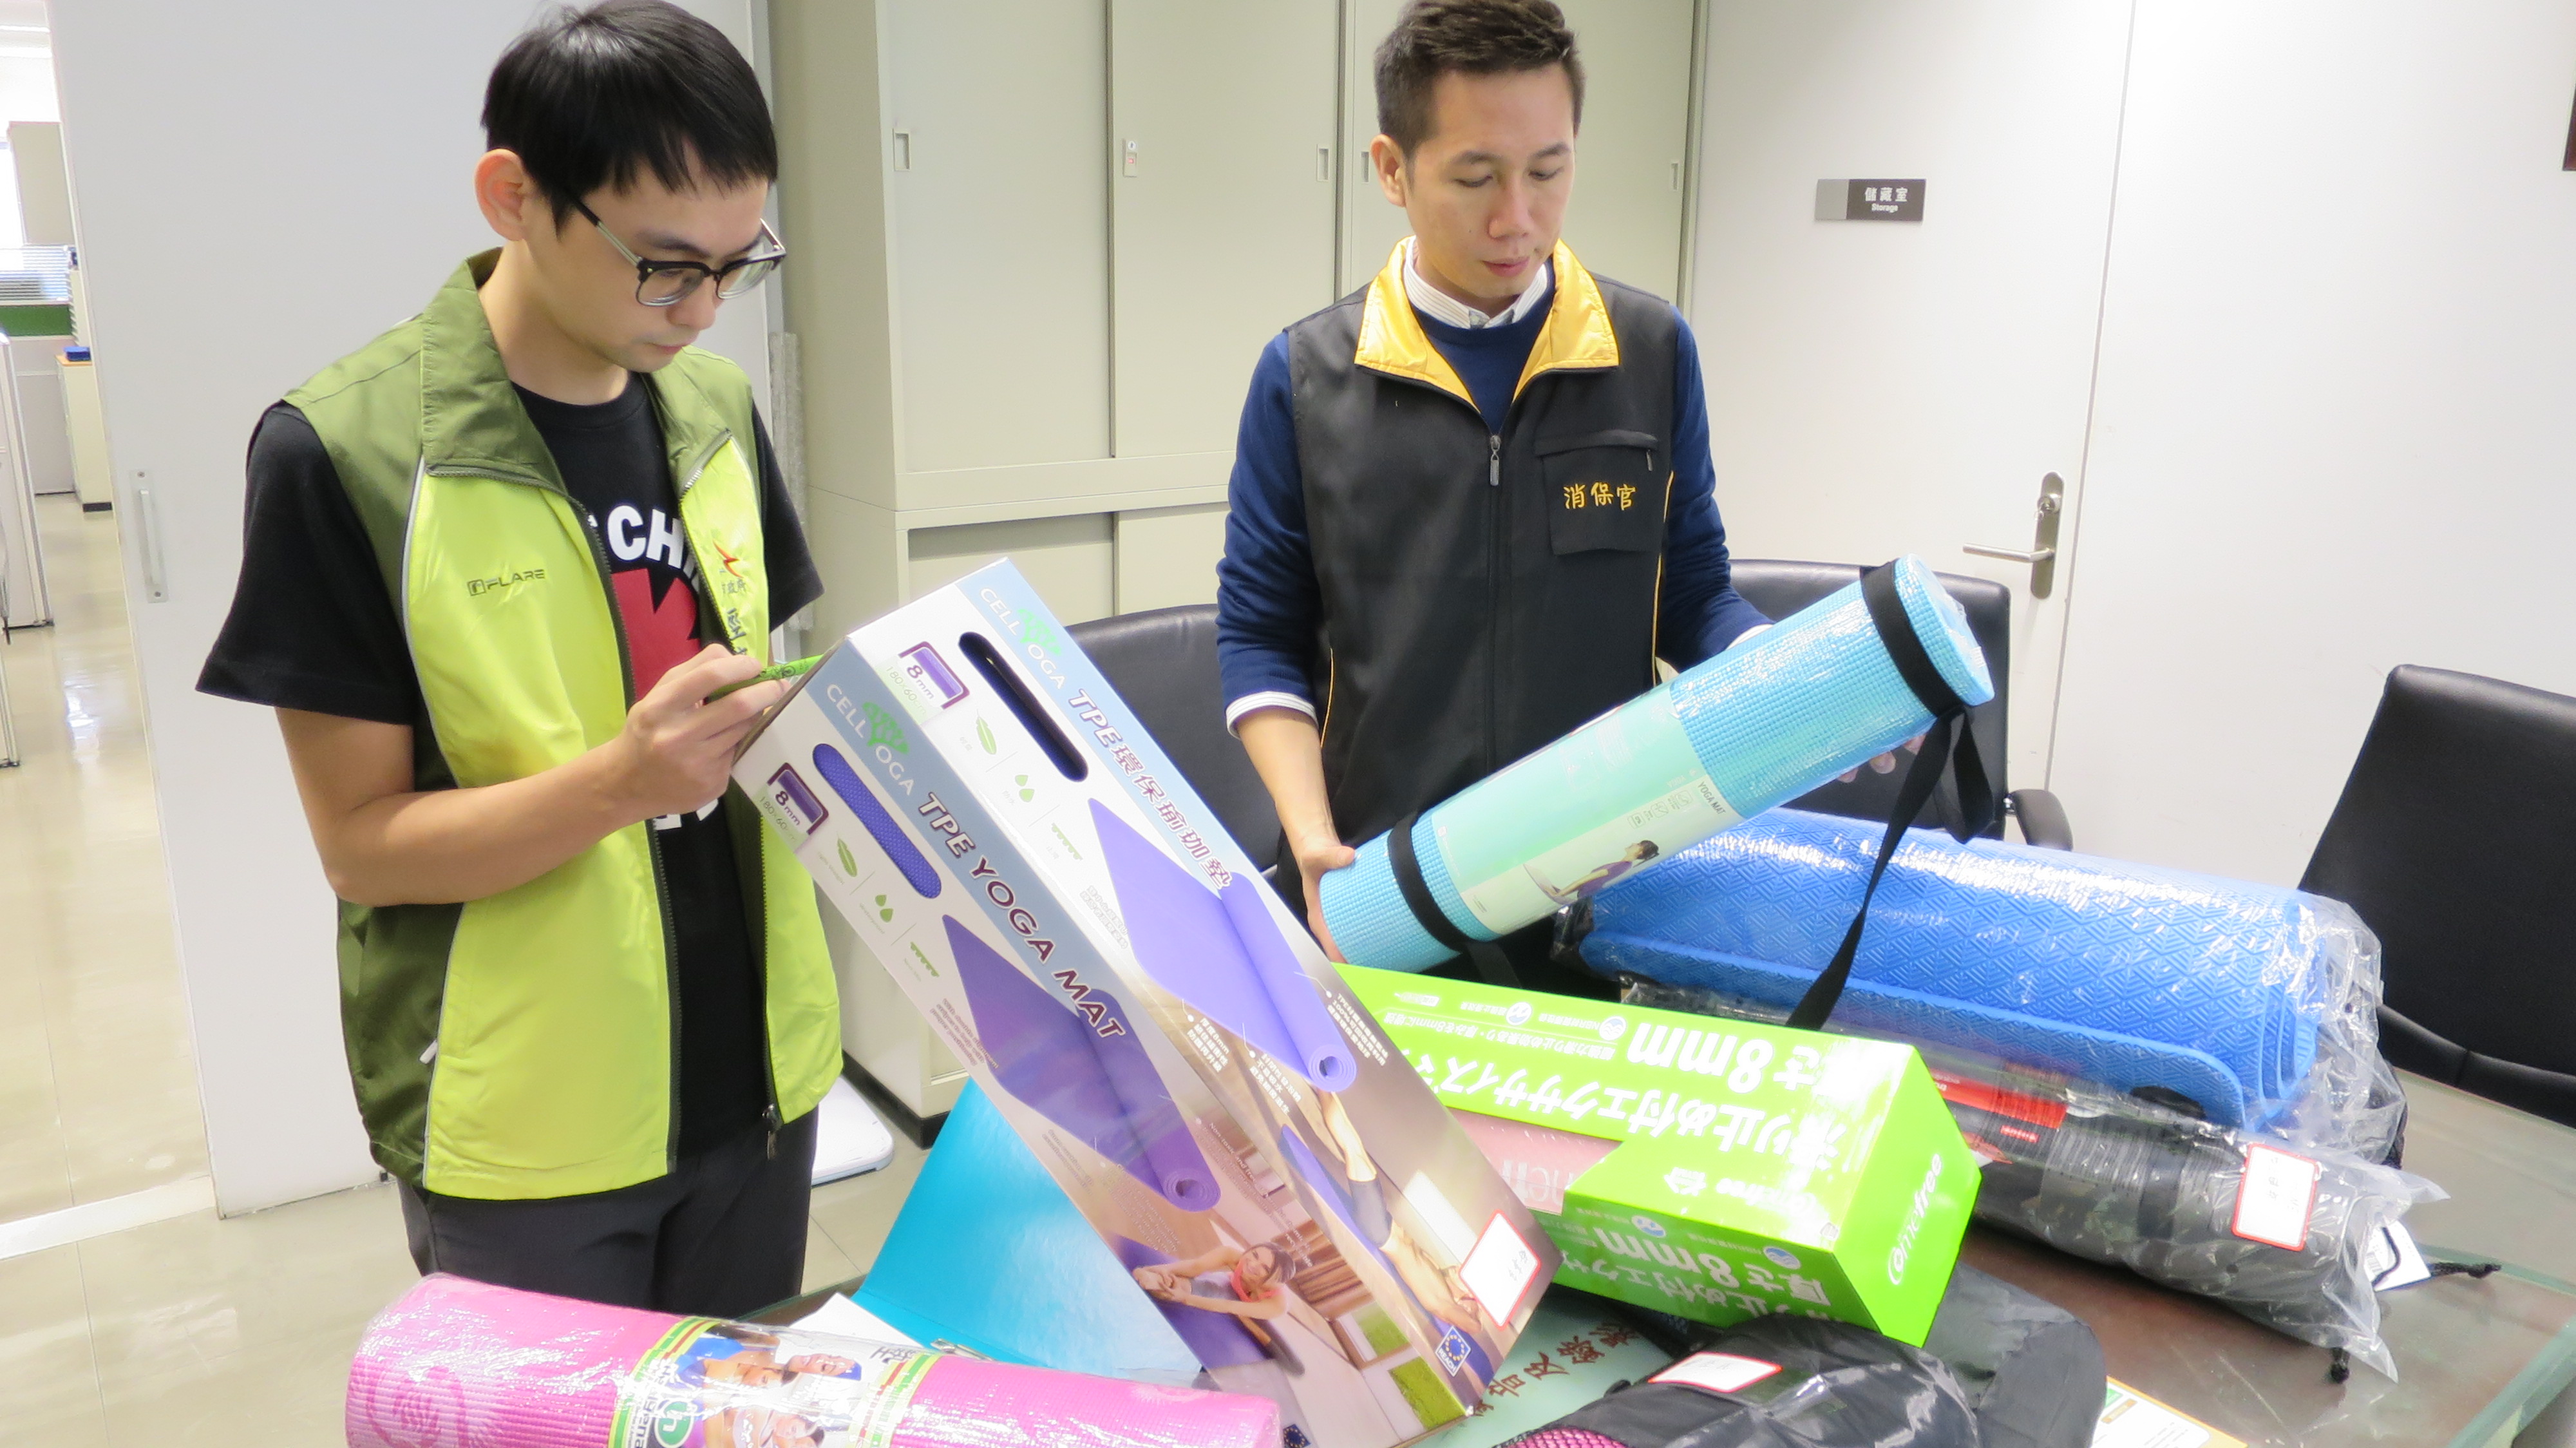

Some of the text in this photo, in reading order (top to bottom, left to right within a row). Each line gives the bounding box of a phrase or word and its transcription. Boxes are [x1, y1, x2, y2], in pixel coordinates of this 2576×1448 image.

[1865, 187, 1908, 202] 儲藏室
[1871, 203, 1899, 213] Storage
[1563, 482, 1636, 510] 消保官
[1696, 780, 1726, 817] YOGA MAT
[918, 792, 1126, 1039] TPE YOGA MAT
[1199, 1017, 1231, 1054] 厚度8mm
[1626, 1022, 1856, 1099] さ8mm
[1437, 1347, 1457, 1372] REACH
